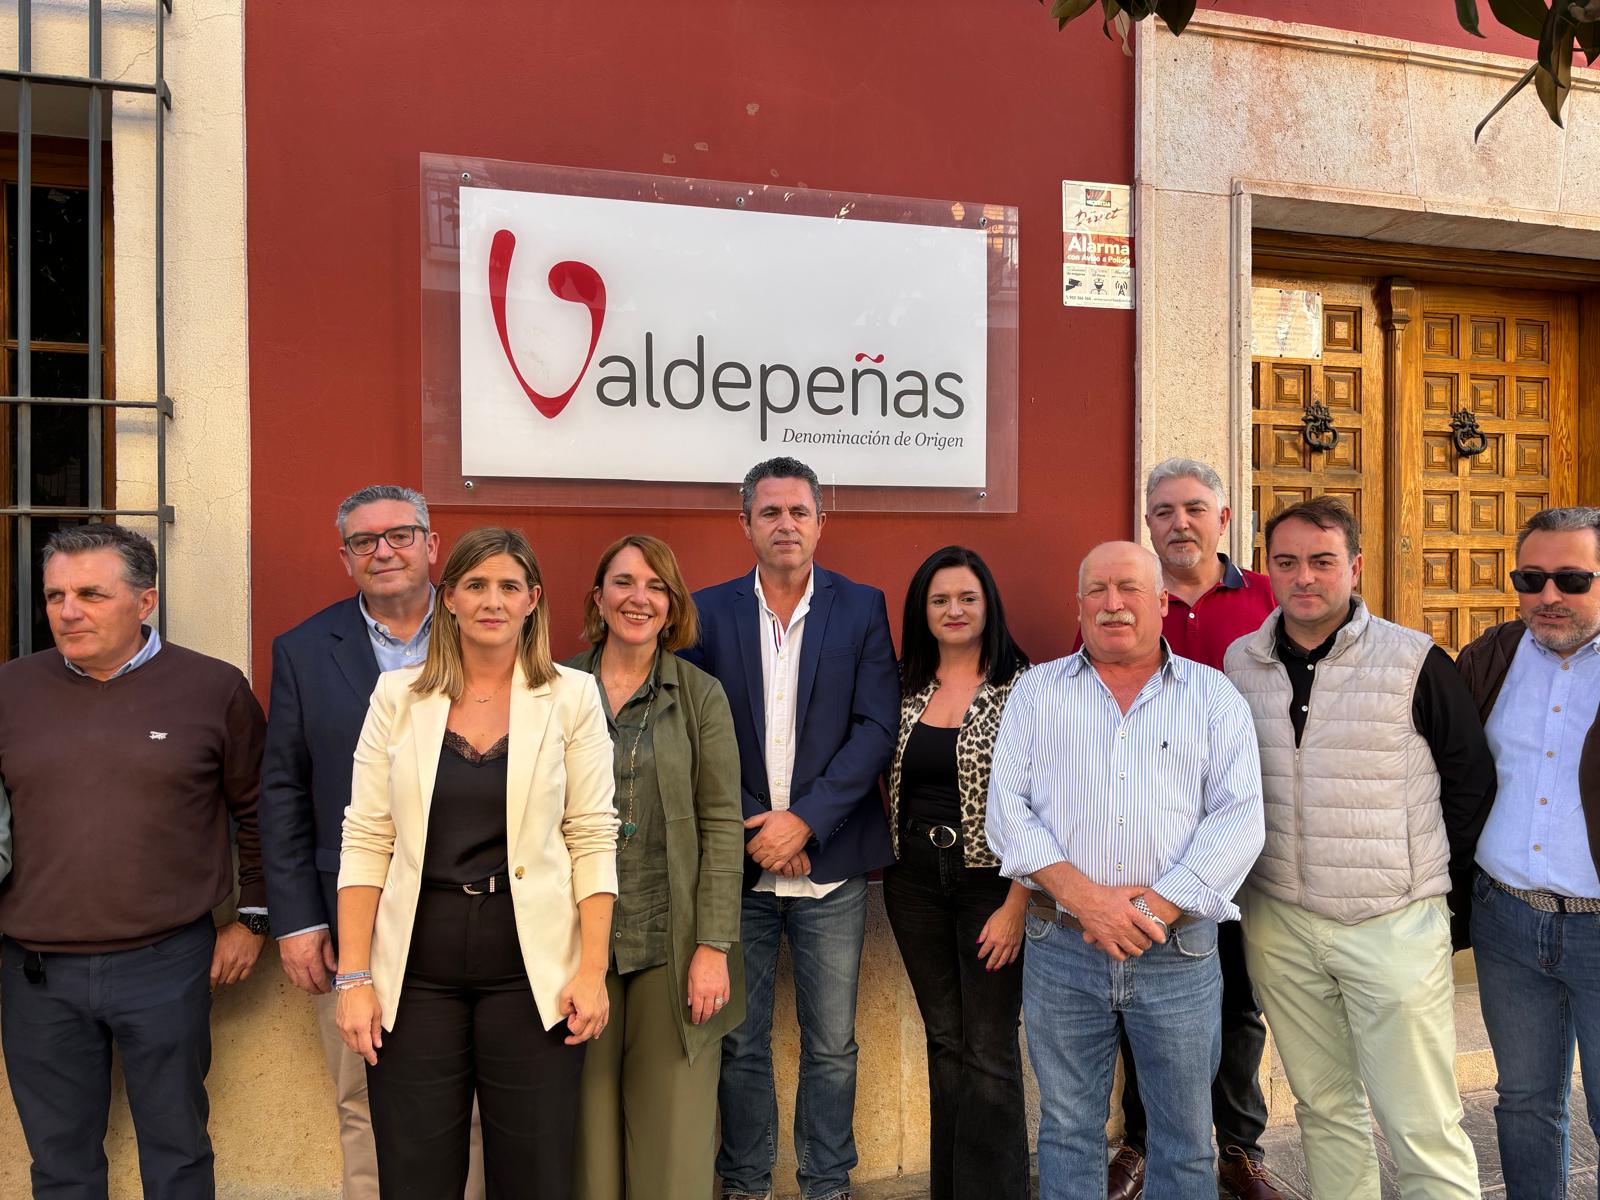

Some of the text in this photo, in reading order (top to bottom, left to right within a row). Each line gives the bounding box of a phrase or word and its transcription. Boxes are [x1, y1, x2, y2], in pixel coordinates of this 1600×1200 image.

[1067, 235, 1130, 255] Alarma
[489, 229, 965, 442] Valdepeñas
[782, 428, 964, 450] Denominación de Origen
